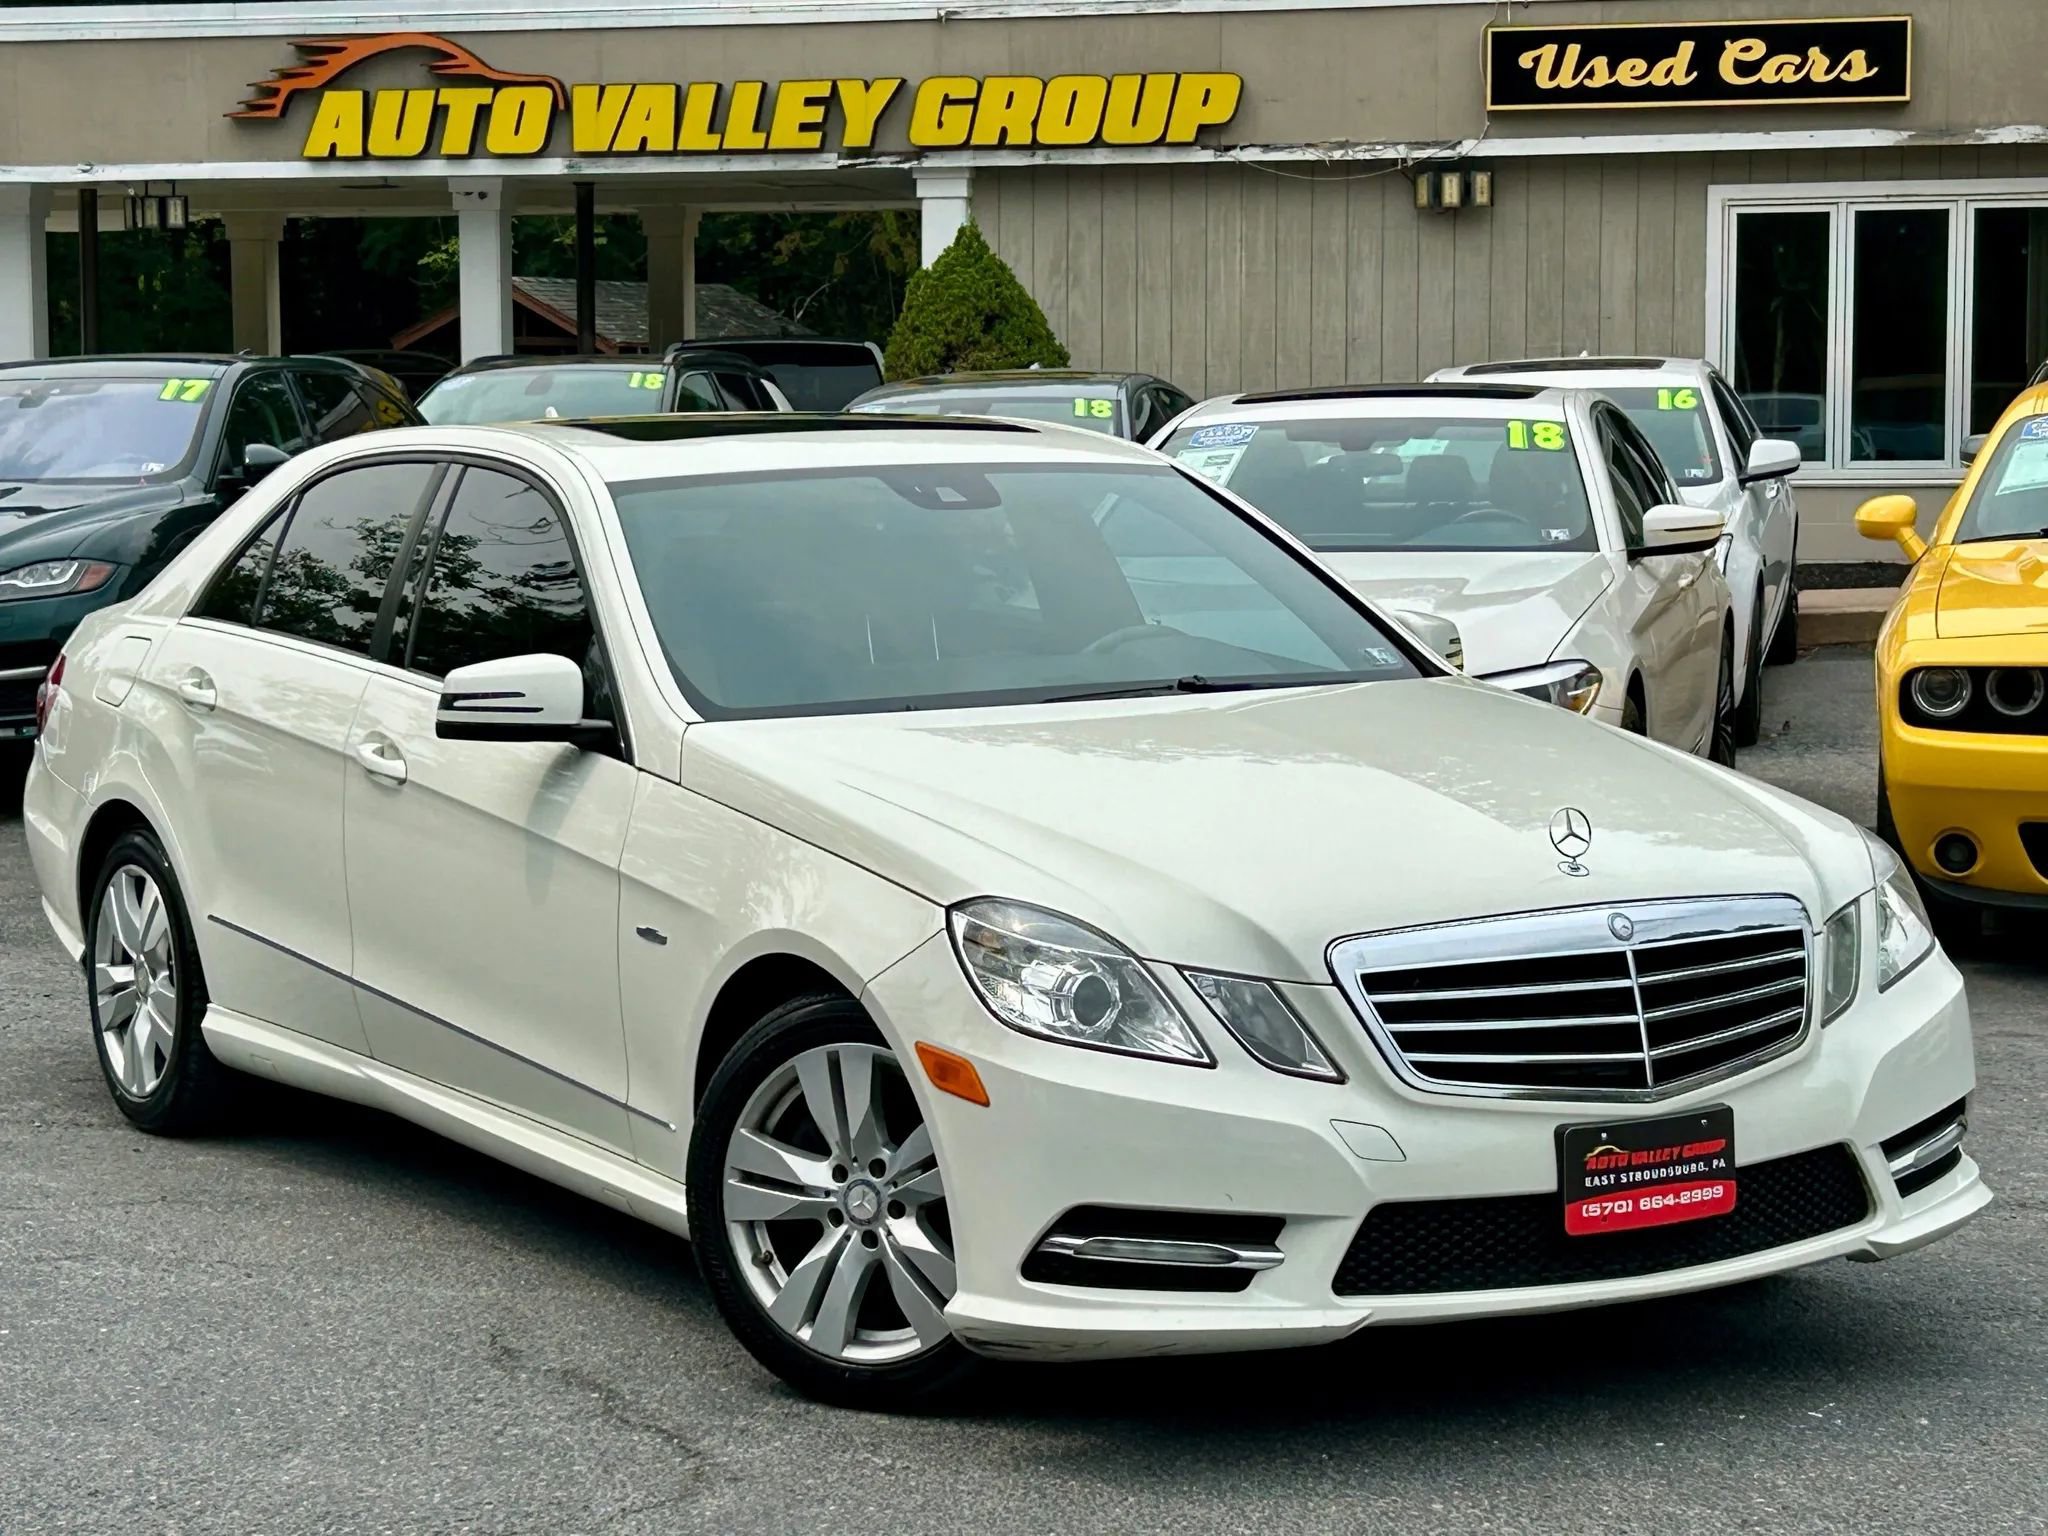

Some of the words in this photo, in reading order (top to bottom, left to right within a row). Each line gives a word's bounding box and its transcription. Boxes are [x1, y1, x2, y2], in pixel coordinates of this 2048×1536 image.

[1518, 40, 1698, 89] Used
[1718, 38, 1879, 86] Cars
[303, 86, 554, 158] AUTO
[571, 78, 904, 153] VALLEY
[909, 73, 1242, 147] GROUP
[160, 379, 211, 401] 17
[629, 372, 665, 389] 18
[1074, 398, 1112, 418] 18
[1657, 388, 1698, 410] 16
[1507, 420, 1565, 450] 18
[1585, 1173, 1616, 1188] EAST
[1712, 1158, 1726, 1170] PA
[1582, 1199, 1633, 1217] (570)
